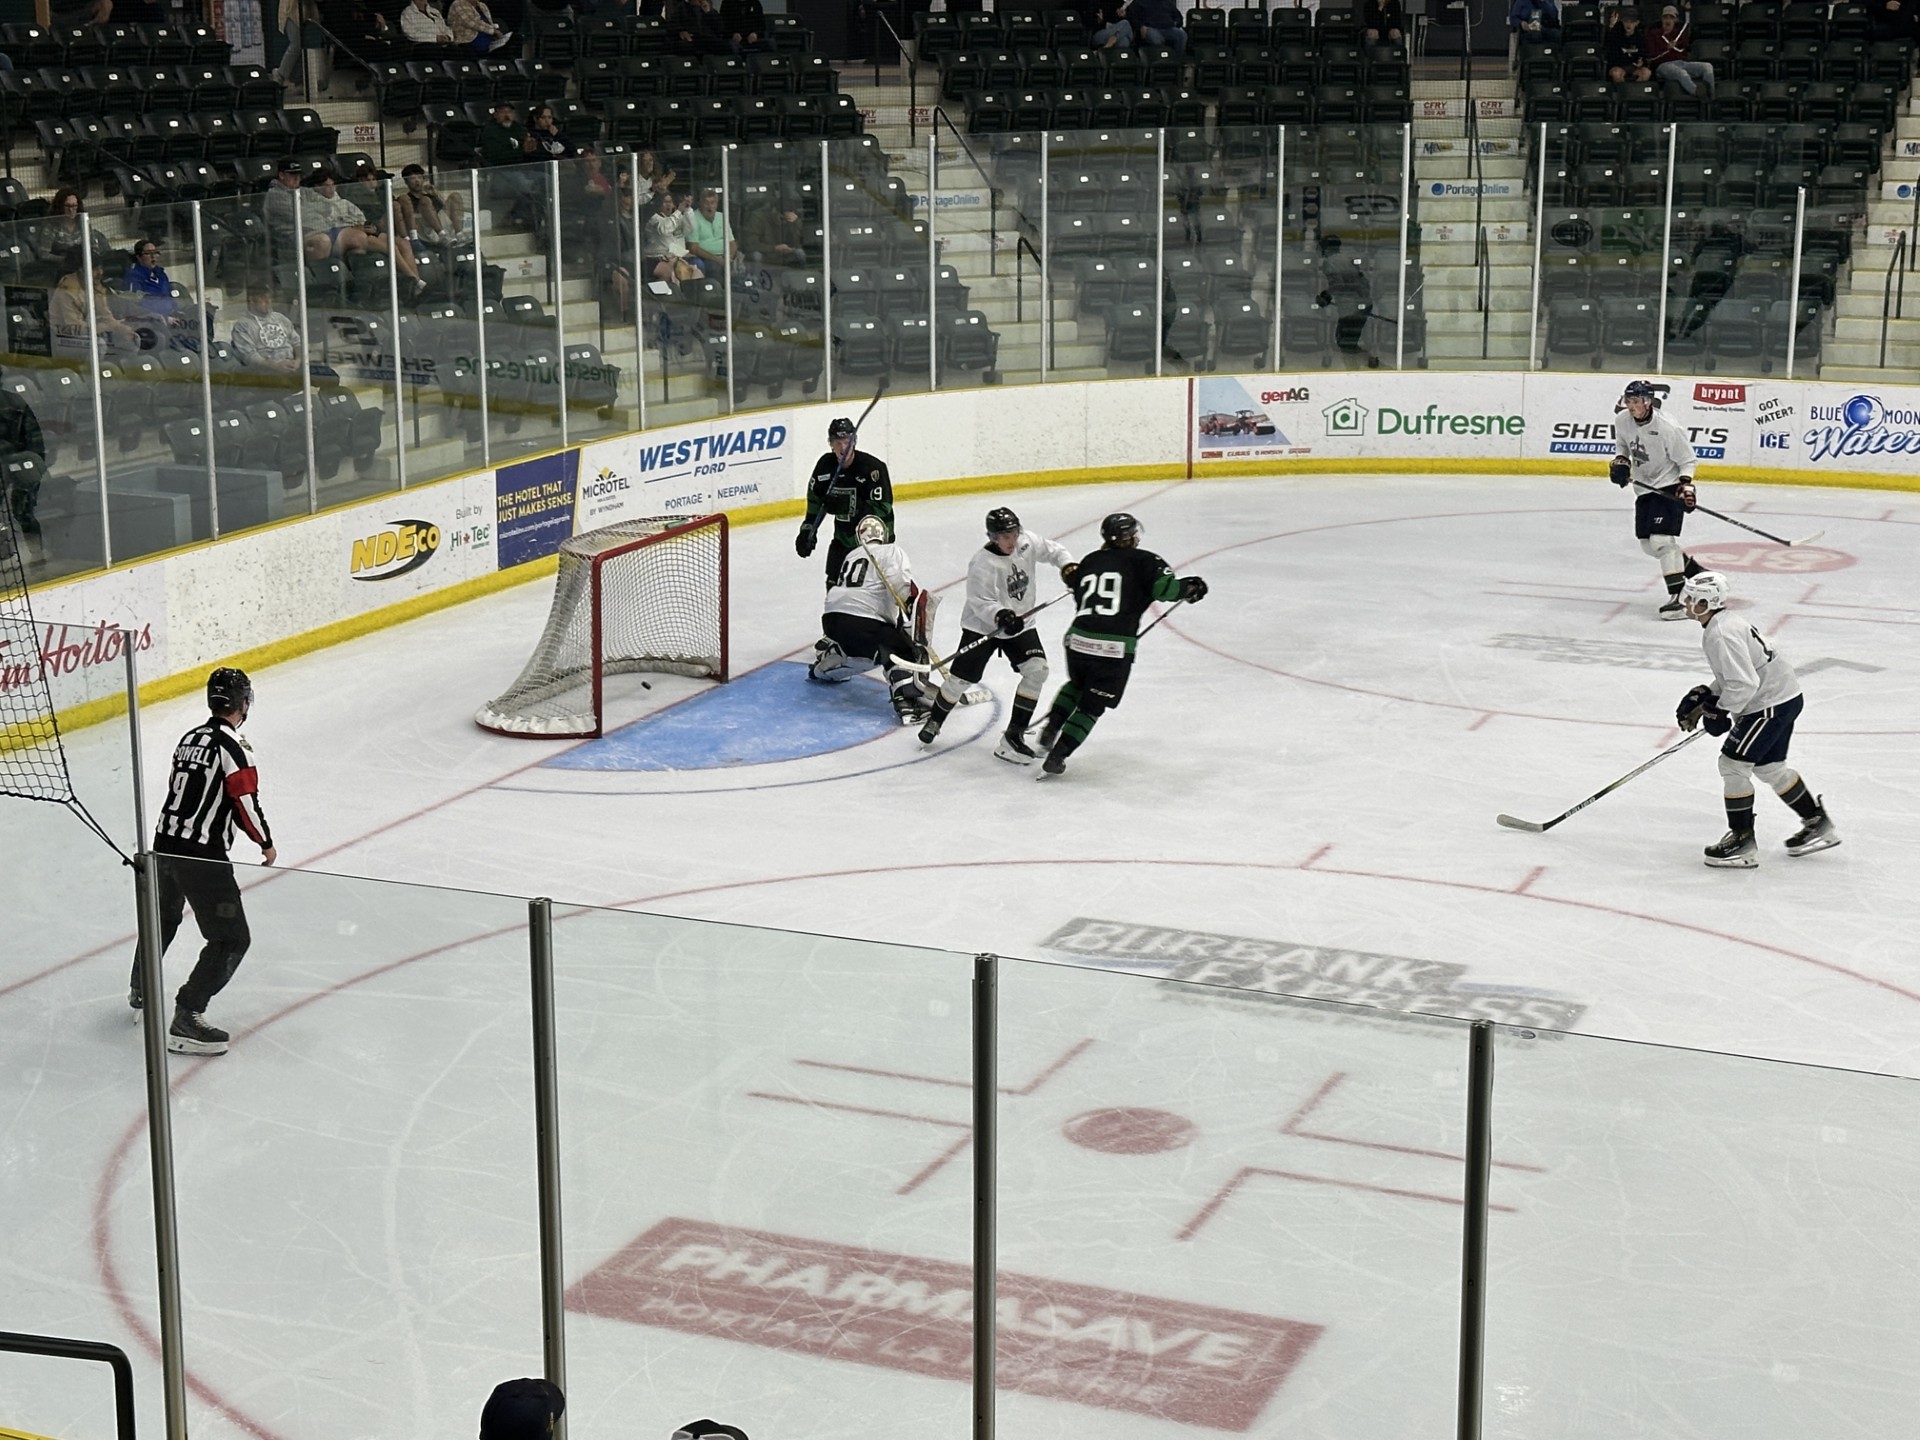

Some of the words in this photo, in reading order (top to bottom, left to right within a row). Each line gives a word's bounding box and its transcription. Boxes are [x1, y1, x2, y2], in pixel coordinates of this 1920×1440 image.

[1424, 101, 1447, 110] CFRY
[1480, 101, 1504, 109] CFRY
[354, 126, 375, 135] CFRY
[1261, 387, 1309, 405] genAG
[1701, 386, 1740, 400] bryant
[1758, 398, 1779, 412] GOT
[1377, 404, 1526, 436] Dufresne
[1754, 406, 1795, 426] WATER?
[1810, 406, 1842, 422] BLUE
[1884, 410, 1920, 425] MOON
[639, 425, 786, 473] WESTWARD
[1760, 431, 1790, 449] ICE
[1803, 423, 1920, 462] Water
[694, 461, 726, 477] FORD
[498, 493, 513, 508] THE
[514, 487, 541, 503] HOTEL
[541, 480, 562, 496] THAT
[582, 477, 630, 500] MICROTEL
[665, 493, 703, 510] PORTAGE
[717, 483, 759, 500] NEEPAWA
[473, 504, 483, 516] by
[498, 507, 517, 523] JUST
[518, 499, 546, 517] MAKES
[547, 492, 573, 510] SENSE.
[1077, 571, 1122, 617] 29
[39, 620, 151, 682] Hortons
[960, 635, 988, 654] CCM
[1090, 688, 1115, 699] CCM
[168, 771, 189, 811] 9
[1064, 920, 1440, 990] BURBANK
